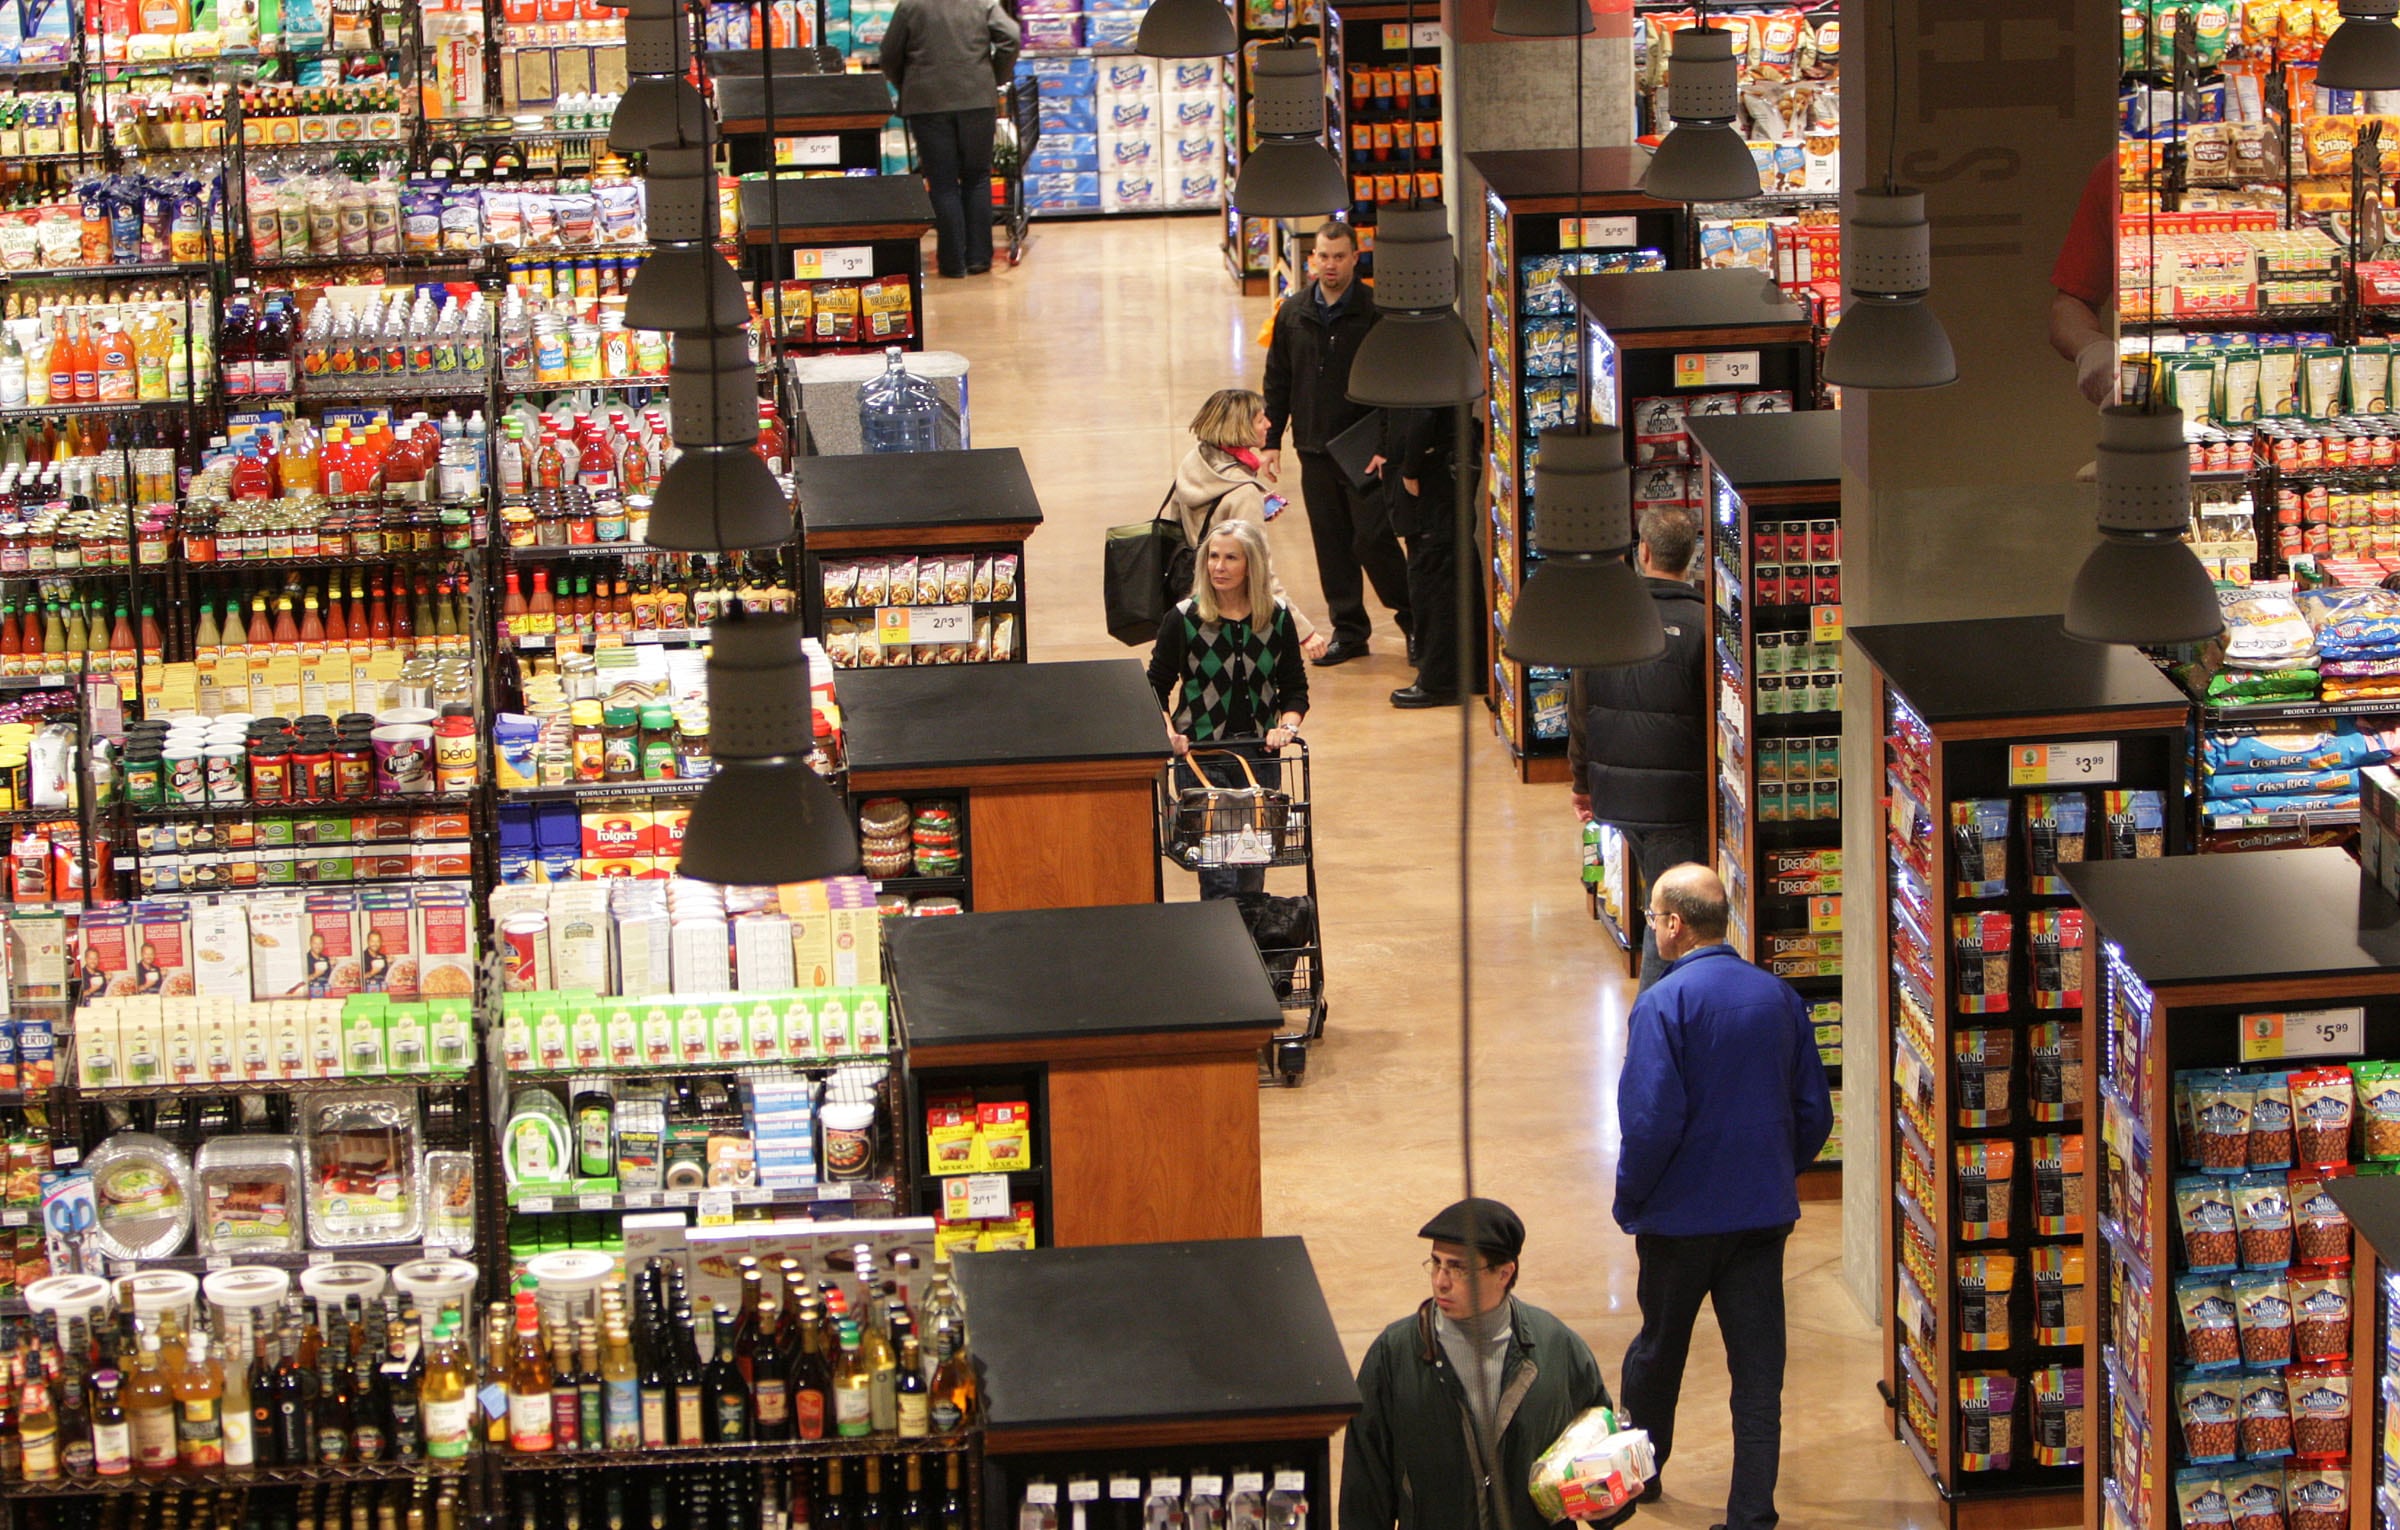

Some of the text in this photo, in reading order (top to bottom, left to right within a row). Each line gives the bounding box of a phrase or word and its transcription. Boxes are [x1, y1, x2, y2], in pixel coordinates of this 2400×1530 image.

[2315, 131, 2348, 144] Ginger
[2317, 140, 2353, 154] Snaps
[609, 340, 622, 356] V8
[235, 414, 261, 424] BRITA
[440, 748, 472, 762] pero
[2280, 755, 2302, 765] Rice
[2256, 778, 2310, 793] Crispy Rice
[2108, 814, 2136, 824] KIND
[597, 830, 638, 844] Folgers
[1778, 856, 1820, 872] BRETON
[1778, 880, 1820, 895] BRETON
[1954, 937, 1983, 949] KIND
[2031, 932, 2060, 944] KIND
[1775, 938, 1816, 952] BRETON
[1773, 961, 1815, 976] BRETON
[18, 1034, 50, 1046] CERTO
[2032, 1046, 2060, 1056] KIND
[1955, 1052, 1984, 1063] KIND
[2258, 1102, 2280, 1111] BLUE
[2316, 1100, 2336, 1108] BLUE
[2306, 1106, 2345, 1116] DIAMOND
[2034, 1158, 2062, 1170] KIND
[1958, 1165, 1986, 1176] KIND
[2202, 1204, 2222, 1212] BLUE
[2192, 1211, 2232, 1221] DIAMOND
[1958, 1276, 1986, 1287] KIND
[2034, 1270, 2062, 1282] KIND
[2204, 1301, 2223, 1309] BLUE
[2195, 1307, 2234, 1317] DIAMOND
[2036, 1392, 2065, 1402] KIND
[2200, 1396, 2218, 1404] BLUE
[2313, 1391, 2332, 1399] BLUE
[1961, 1398, 1990, 1409] KIND
[2188, 1402, 2231, 1412] DIAMOND
[2303, 1397, 2344, 1407] DIAMOND
[2250, 1488, 2268, 1496] BLUE
[2309, 1484, 2328, 1492] BLUE
[2202, 1495, 2220, 1503] BLUE
[2240, 1493, 2278, 1504] DIAMOND
